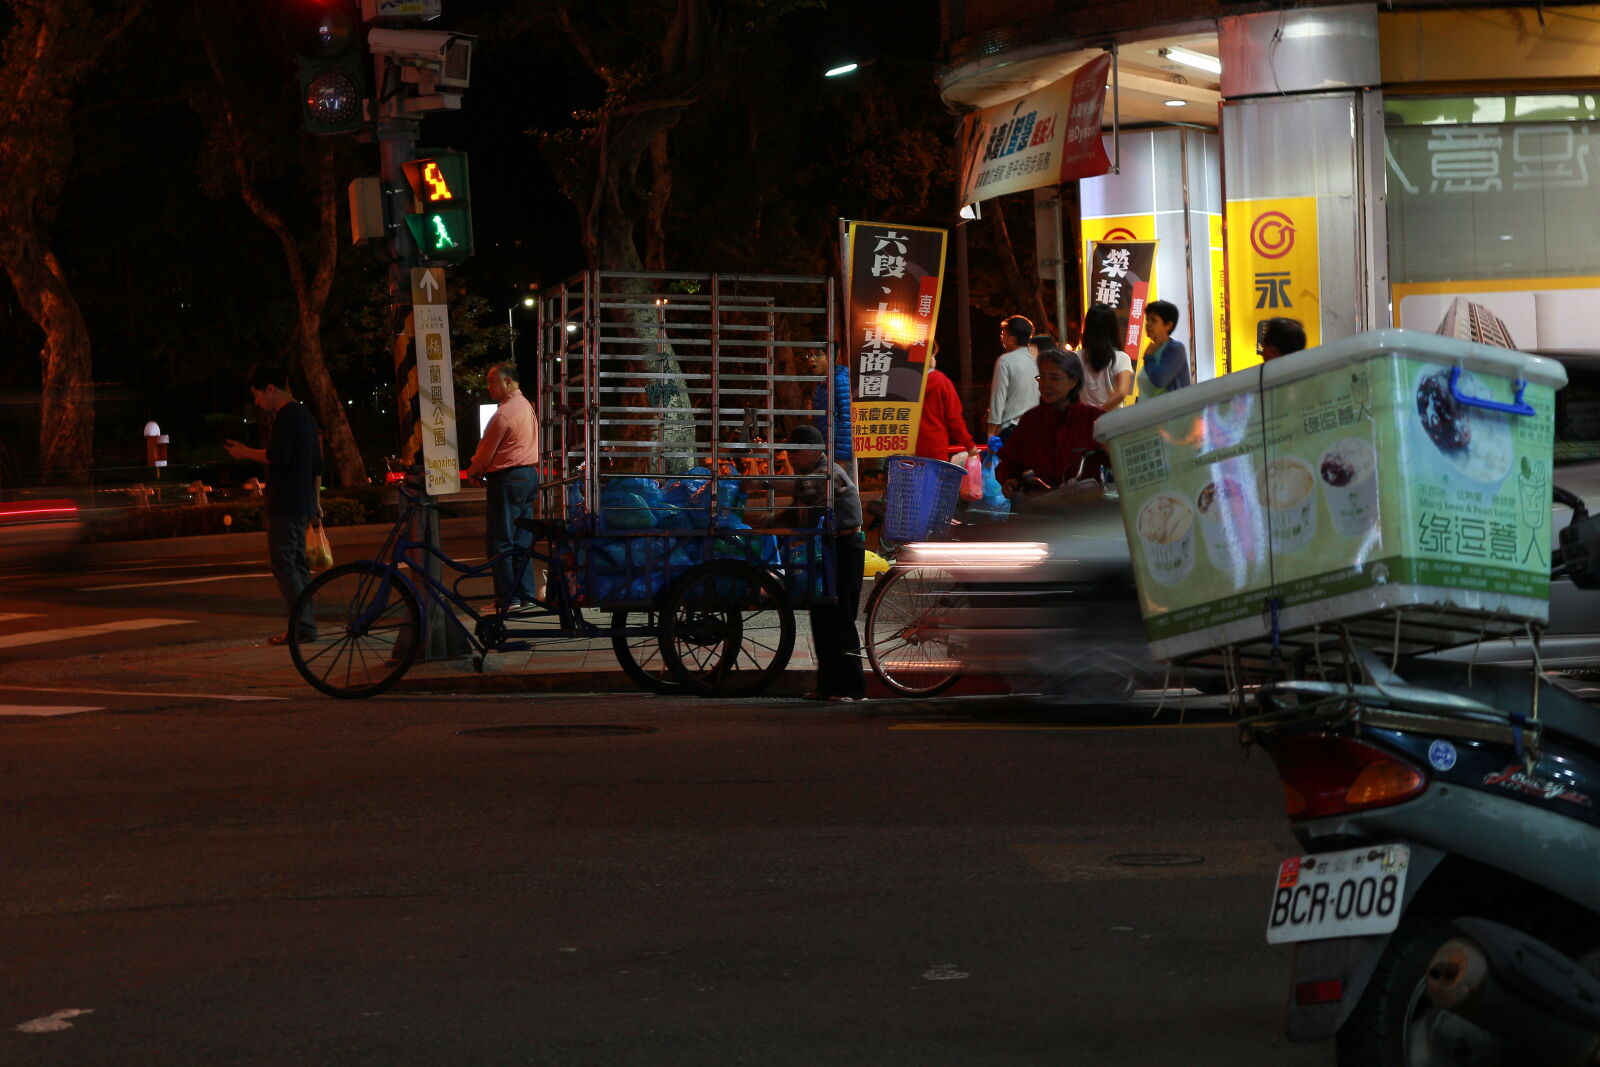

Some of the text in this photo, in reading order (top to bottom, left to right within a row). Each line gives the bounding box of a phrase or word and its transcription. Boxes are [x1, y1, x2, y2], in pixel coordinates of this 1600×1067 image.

[1127, 298, 1144, 346] 專賣
[428, 365, 446, 446] 蘭興公園
[858, 408, 911, 421] 永慶房屋
[427, 457, 457, 470] Lanxing
[428, 475, 446, 487] Park
